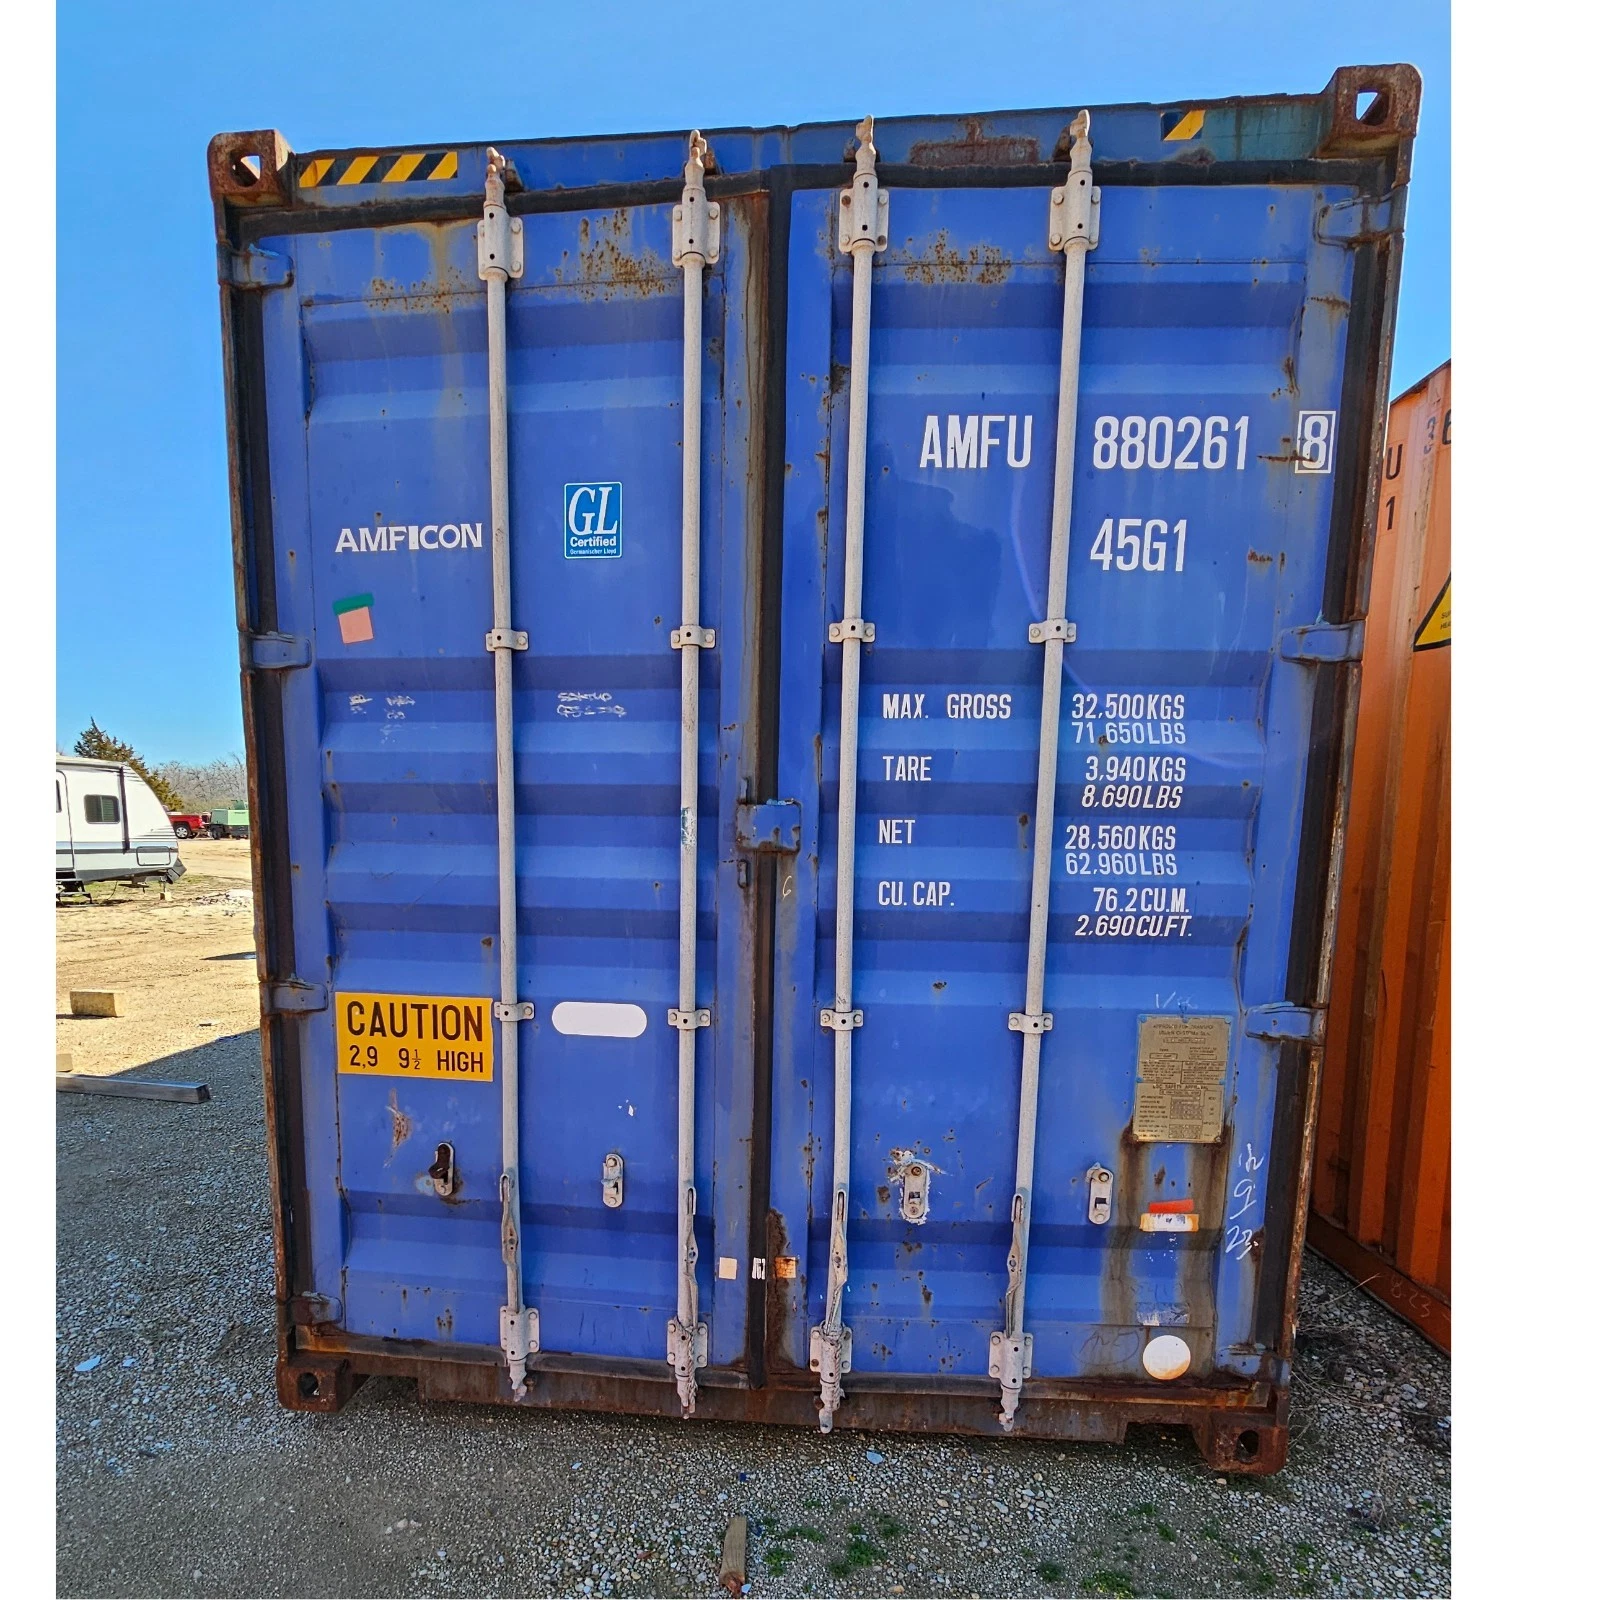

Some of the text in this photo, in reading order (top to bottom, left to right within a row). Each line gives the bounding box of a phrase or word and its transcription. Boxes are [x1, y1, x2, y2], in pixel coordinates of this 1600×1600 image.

[920, 415, 1329, 470] AMFU 880261 8
[568, 486, 618, 535] GL
[335, 523, 482, 552] AMFICON
[570, 536, 616, 547] Certified
[1090, 519, 1187, 572] 45G1
[882, 693, 928, 719] MAX.
[946, 693, 1012, 719] GROSS
[1071, 722, 1186, 745] 71650LBS
[882, 756, 932, 782] TARE
[878, 819, 916, 844] NET
[347, 1000, 483, 1042] CAUTION
[349, 1045, 378, 1069] 2,9
[437, 1050, 484, 1073] HIGH
